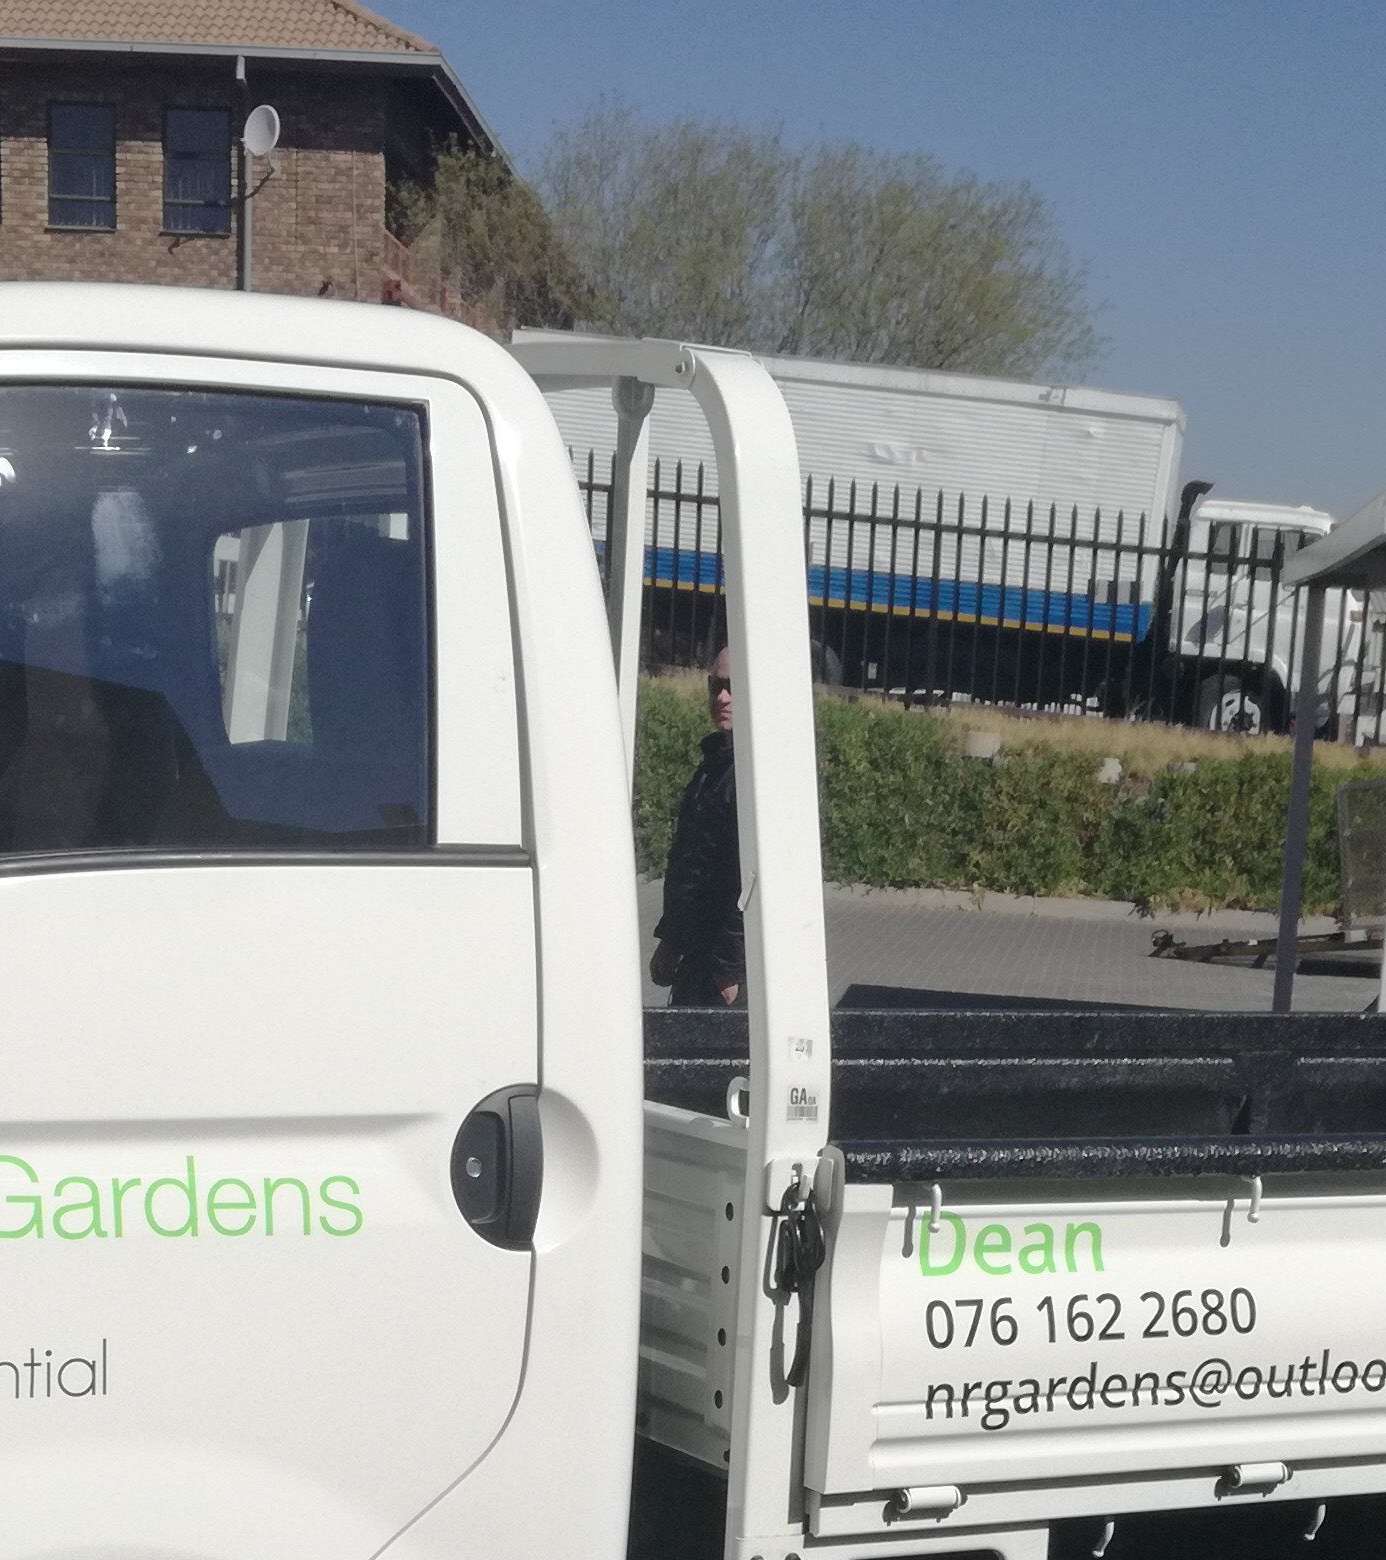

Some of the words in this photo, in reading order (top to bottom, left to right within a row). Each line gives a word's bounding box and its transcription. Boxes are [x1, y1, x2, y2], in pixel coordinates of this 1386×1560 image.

[918, 1210, 1105, 1277] Dean
[924, 1298, 1019, 1349] 076
[1035, 1292, 1126, 1344] 162
[1141, 1287, 1257, 1339] 2680
